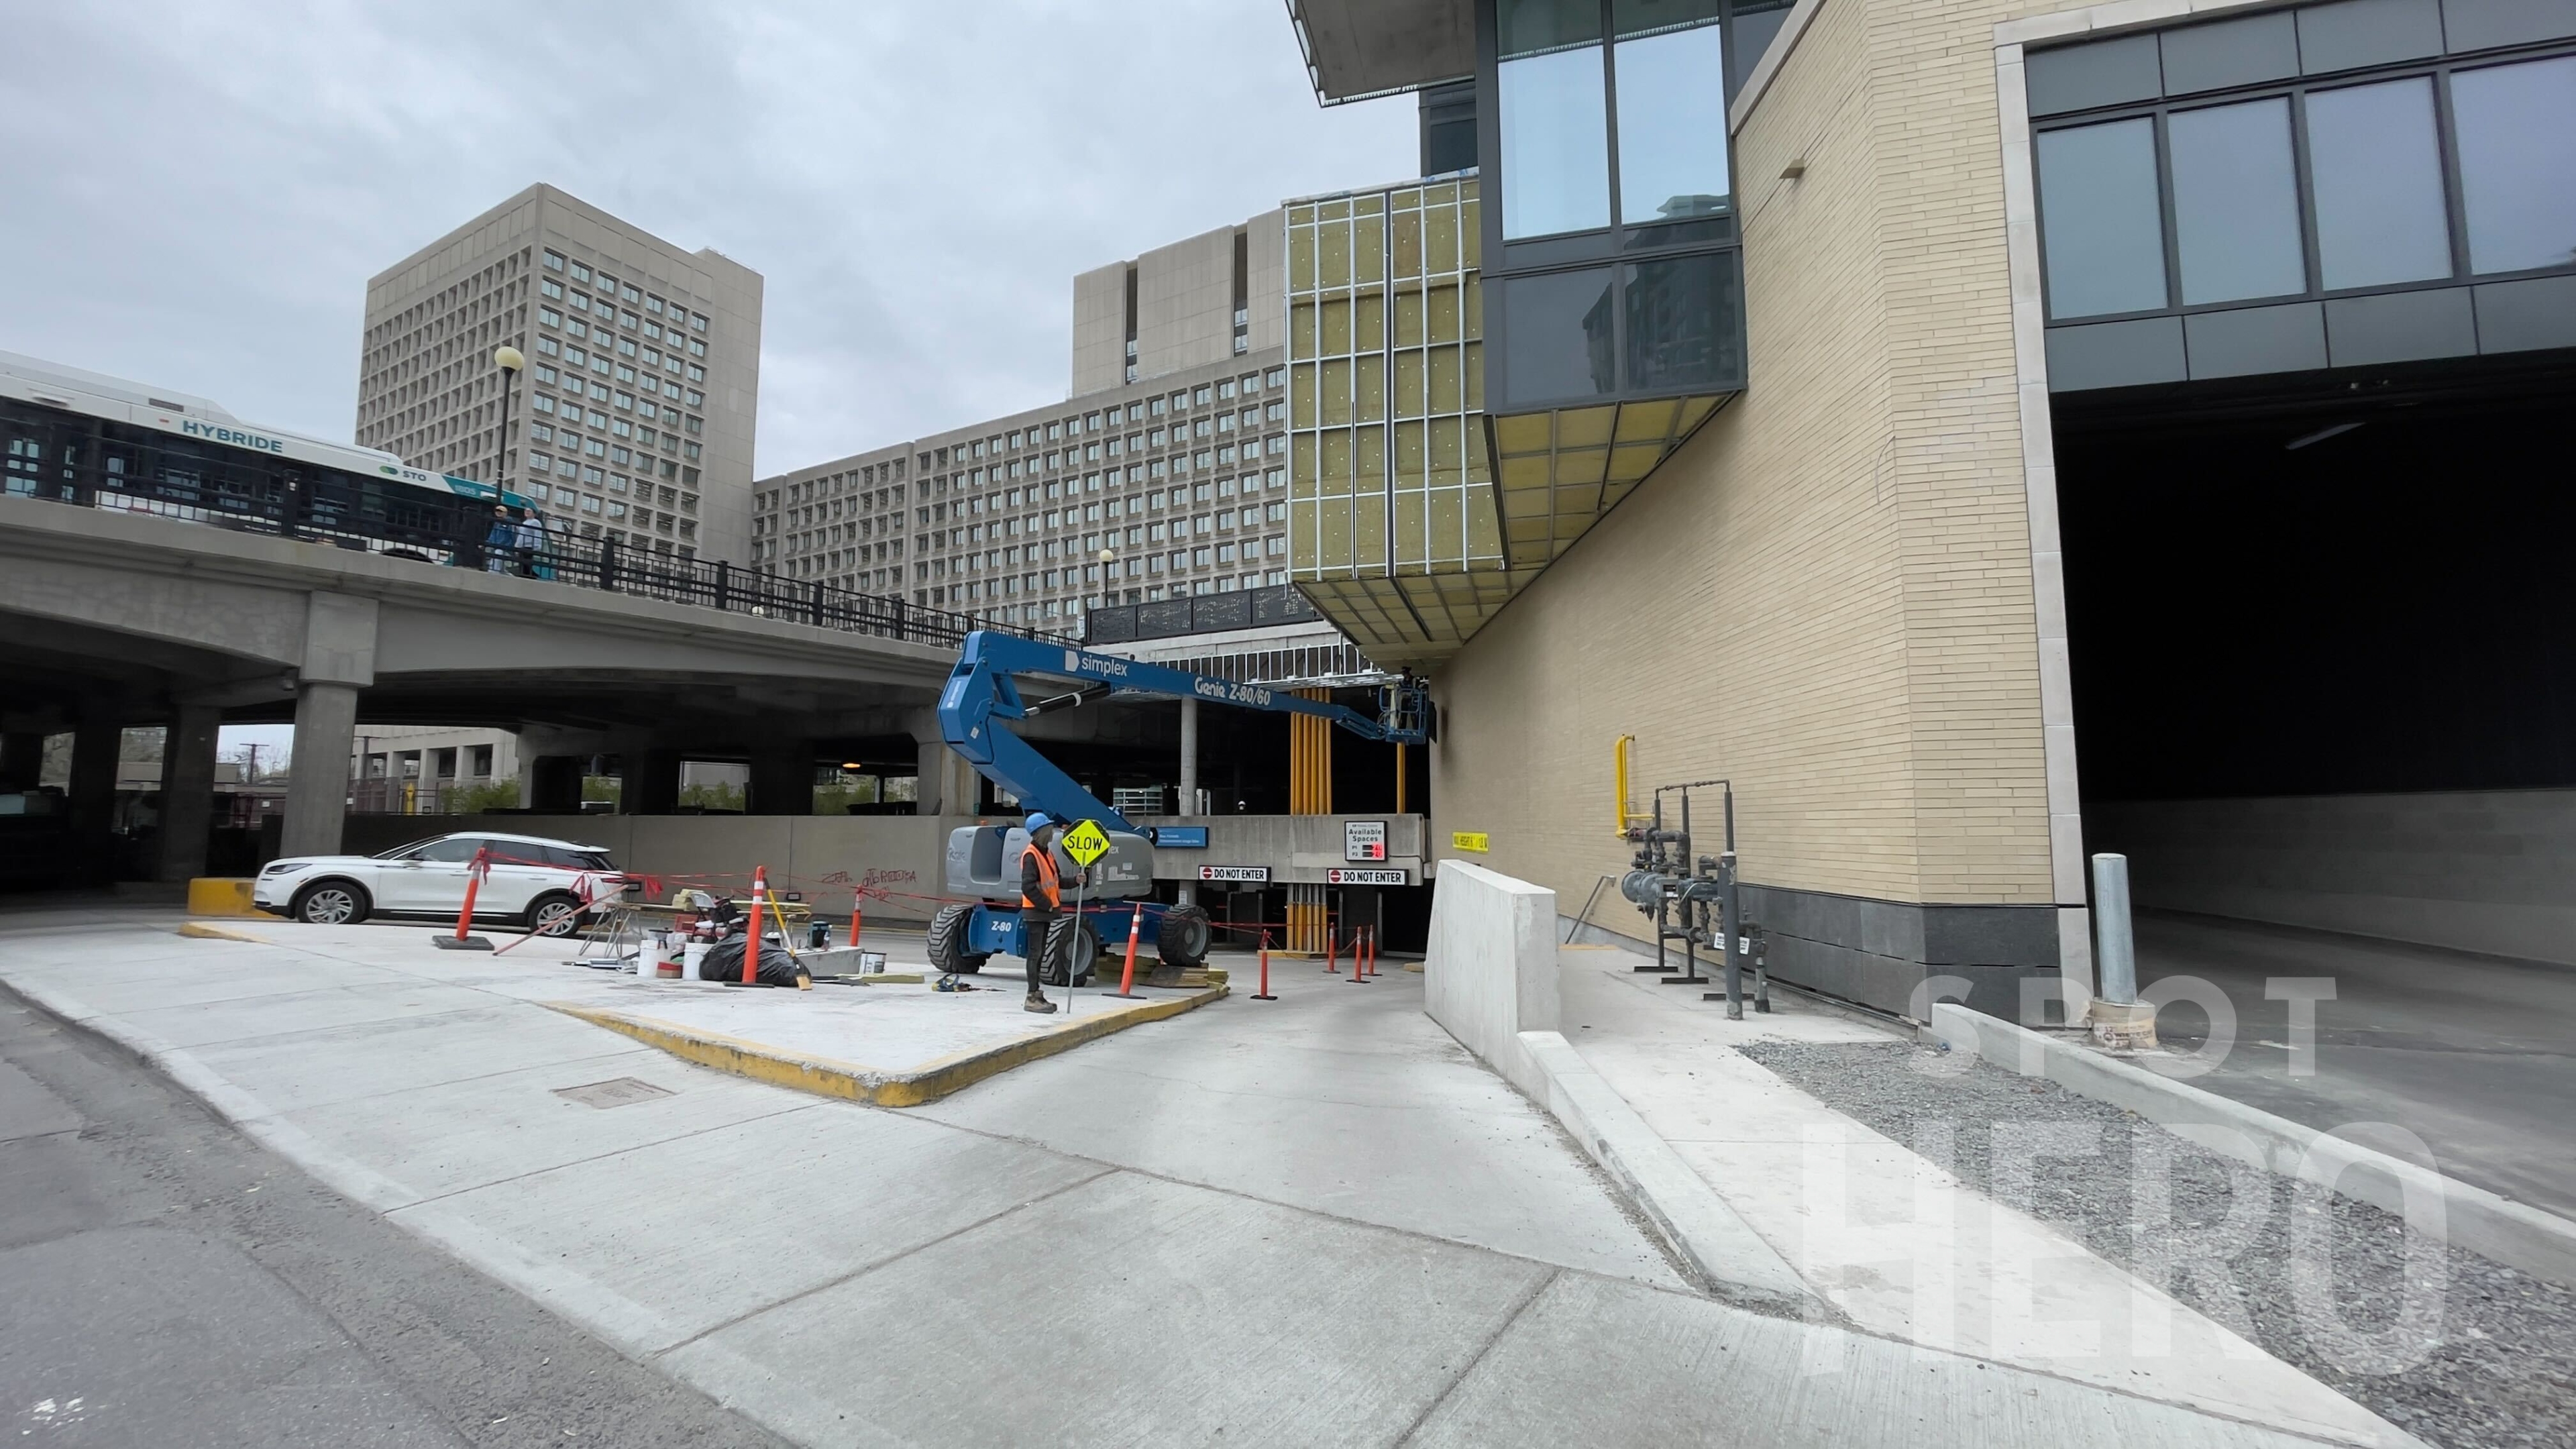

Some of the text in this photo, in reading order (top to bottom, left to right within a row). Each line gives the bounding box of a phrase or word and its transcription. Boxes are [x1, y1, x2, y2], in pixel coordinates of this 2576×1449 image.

[183, 421, 282, 453] HYBRIDE
[403, 471, 427, 481] STO
[1081, 655, 1127, 677] simplex
[1195, 677, 1226, 698] Genie
[1067, 836, 1102, 851] SLOW
[1214, 869, 1264, 879] DO NOT ENTER
[1344, 872, 1401, 883] DO NOT ENTER
[991, 920, 1012, 932] Z-80
